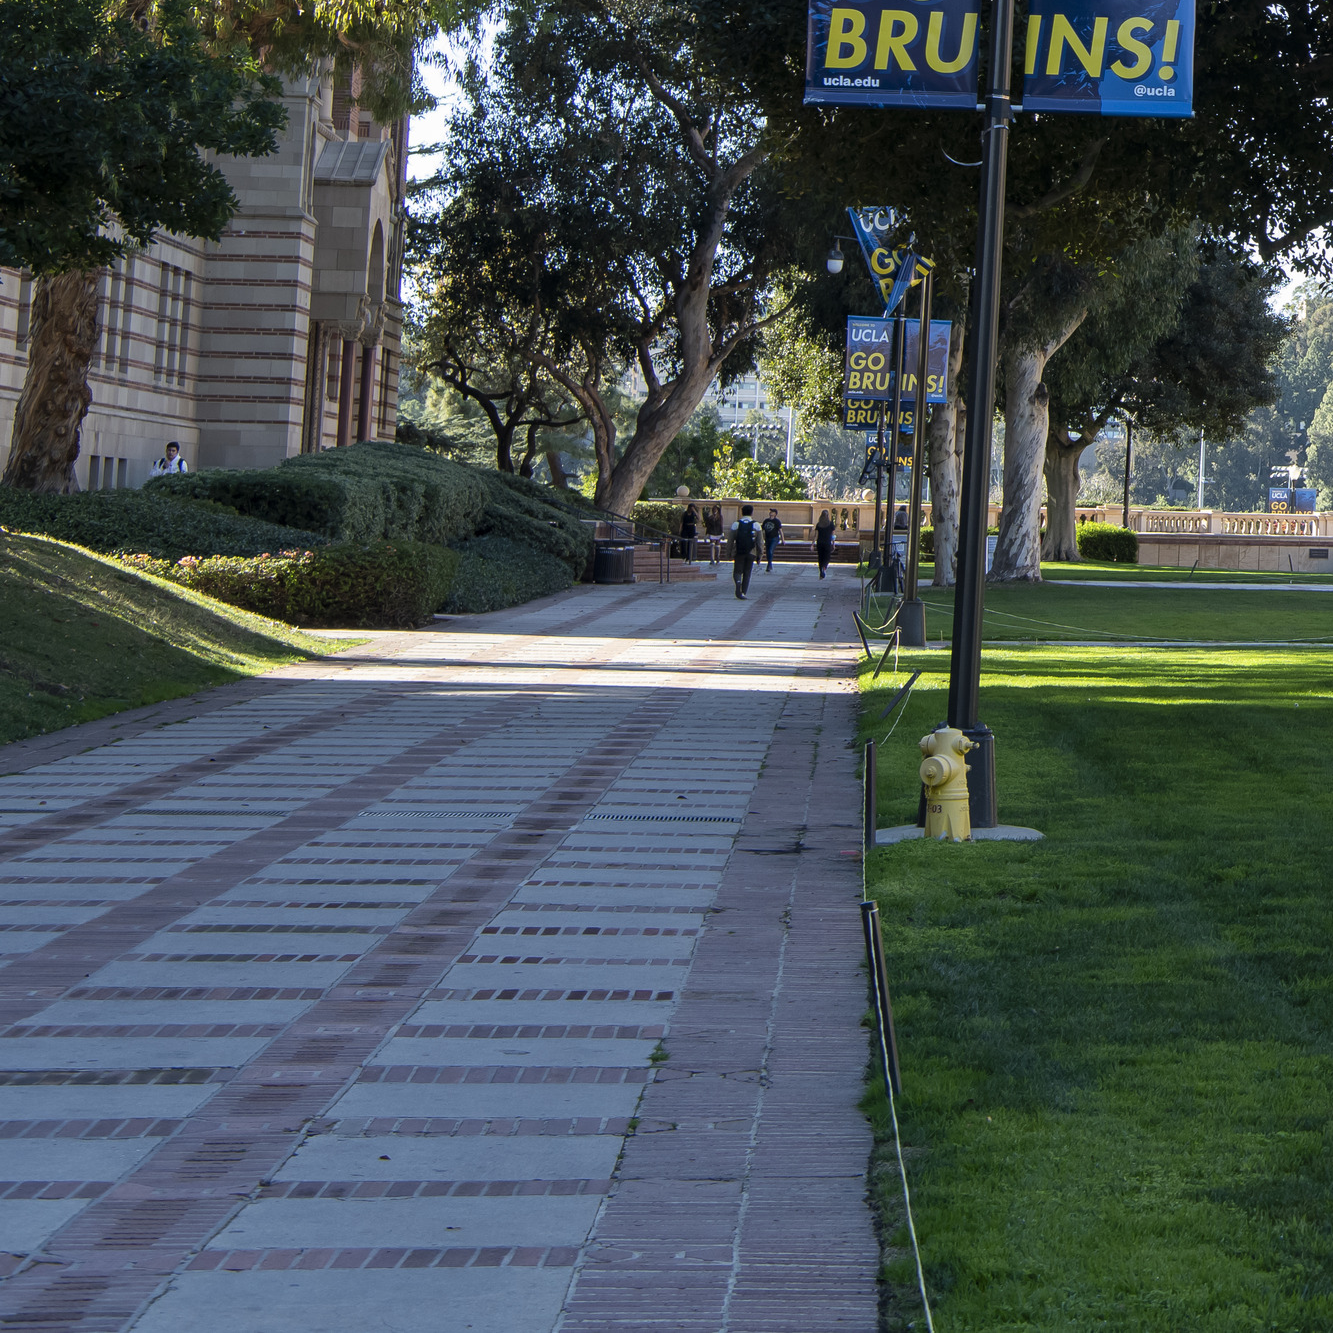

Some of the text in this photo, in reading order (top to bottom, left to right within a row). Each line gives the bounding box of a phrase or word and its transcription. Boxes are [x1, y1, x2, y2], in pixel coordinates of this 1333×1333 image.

[824, 7, 978, 74] BRU
[823, 75, 880, 88] ucla.edu
[1134, 84, 1176, 97] @ucla
[852, 329, 889, 342] UCLA
[850, 352, 885, 370] GO
[1271, 501, 1288, 510] GO
